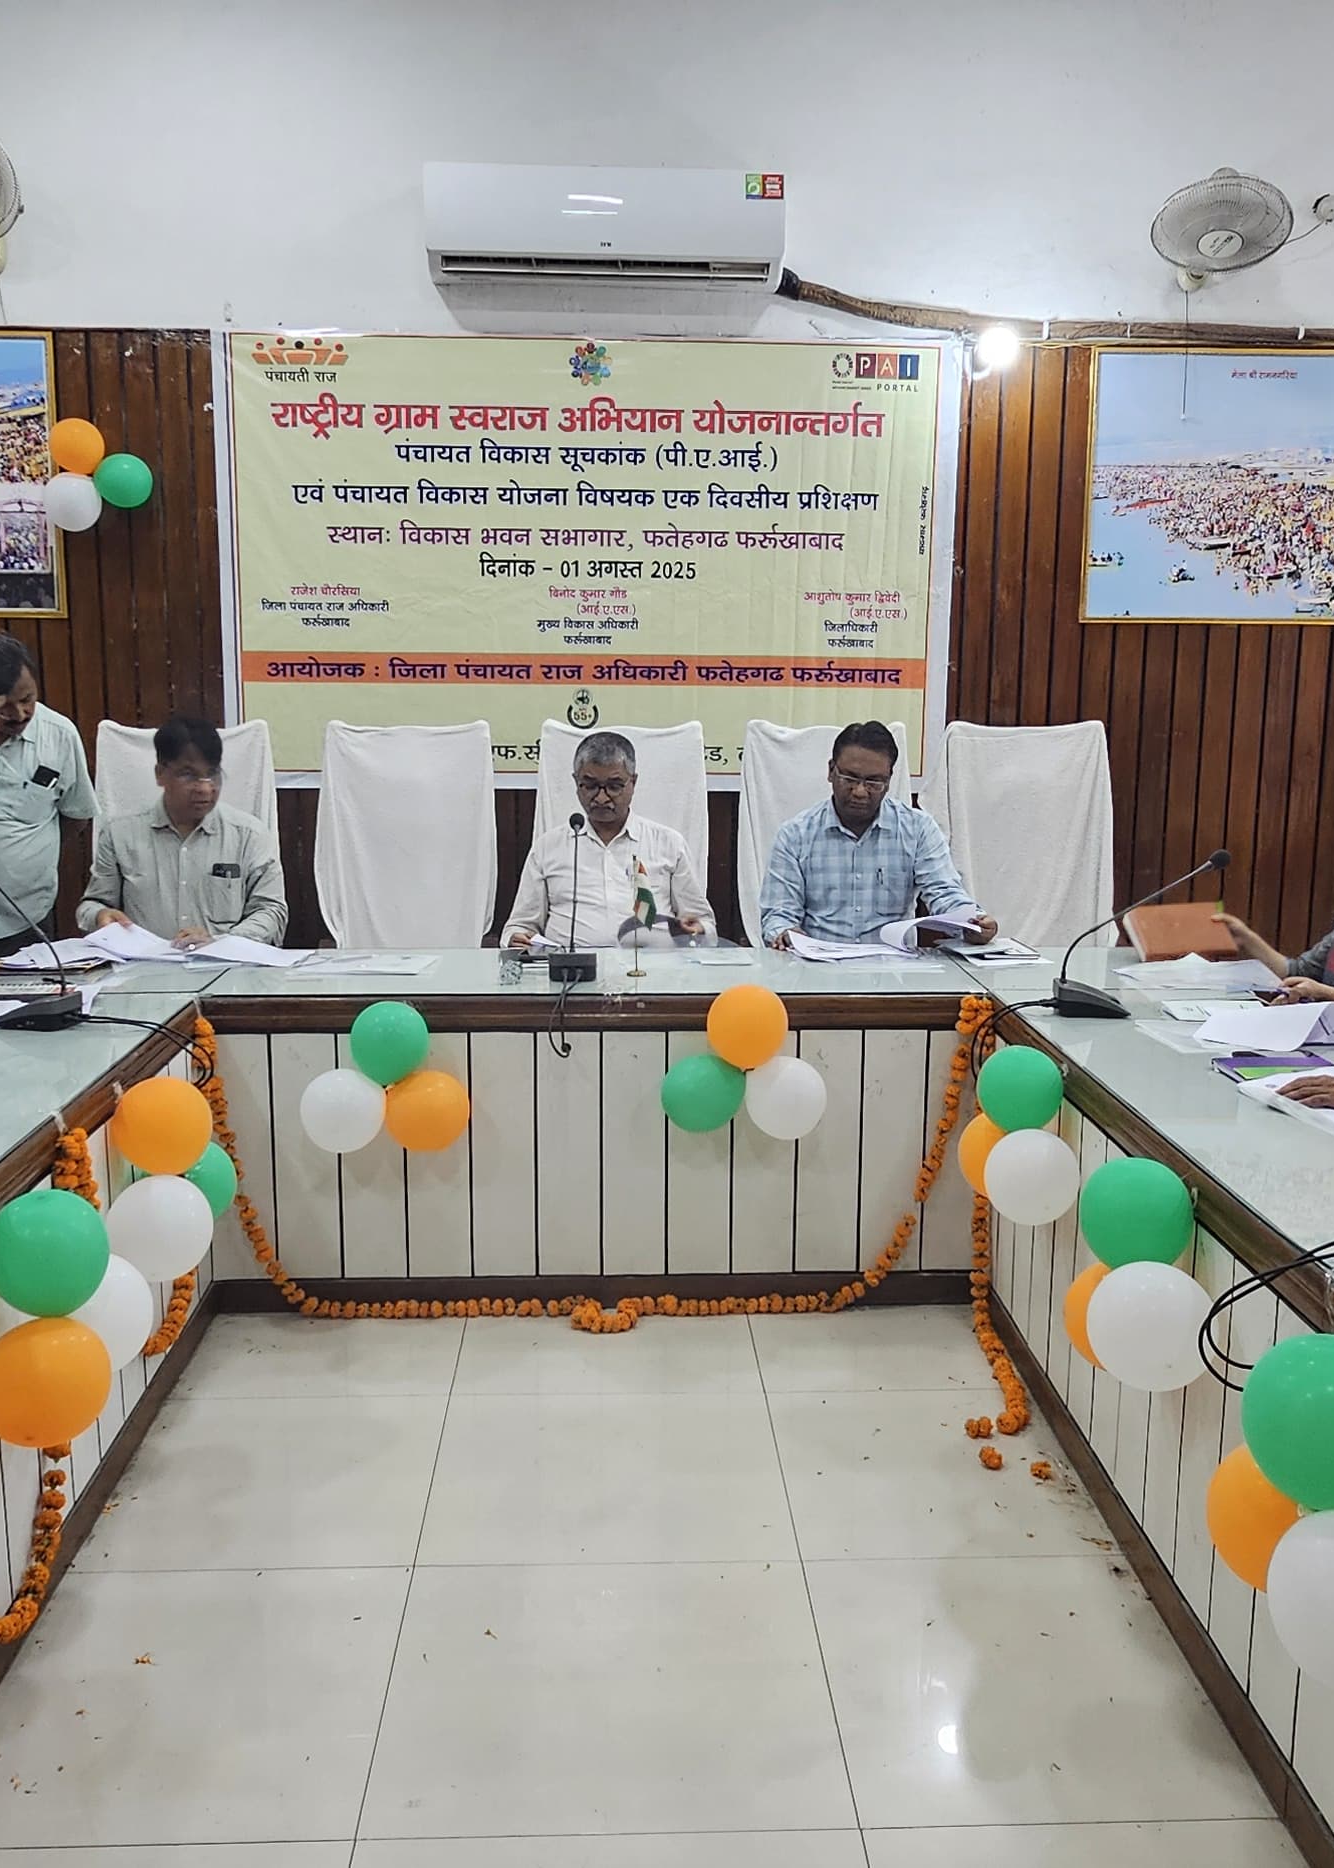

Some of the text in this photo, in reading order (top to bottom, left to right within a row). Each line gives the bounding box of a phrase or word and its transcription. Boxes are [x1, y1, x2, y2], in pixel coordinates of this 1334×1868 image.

[265, 367, 336, 382] पंचायती राज
[858, 356, 913, 378] PAI
[877, 383, 918, 392] PORTAL
[271, 393, 885, 440] राष्ट्रीय ग्राम स्वराज अभियान योजनान्तर्गत
[395, 438, 777, 472] पंचायत विकास सूचकांक (पी.ए.आई.)
[292, 478, 879, 511] एवं पंचायत विकास योजना विषयक एक दिवसीय प्रशिक्षण
[399, 519, 471, 545] विकास
[480, 528, 532, 546] भवन
[539, 529, 633, 552] सभागार,
[479, 552, 536, 578] दिनांक
[560, 560, 579, 578] 01
[587, 560, 643, 578] अगस्त
[651, 560, 696, 580] 2025
[291, 583, 317, 596] राजेश
[579, 589, 606, 602] कुमार
[262, 597, 389, 612] जिला पंचायत राज अधिकारी
[845, 592, 872, 605] कुमार
[537, 616, 639, 633] मुख्य विकास अधिकारी
[824, 620, 878, 633] जिलाधिकारी
[267, 656, 365, 678] आयोजक
[389, 657, 445, 679] जिला
[455, 658, 532, 680] पंचायत
[541, 664, 583, 680] राज
[592, 659, 687, 682] अधिकारी
